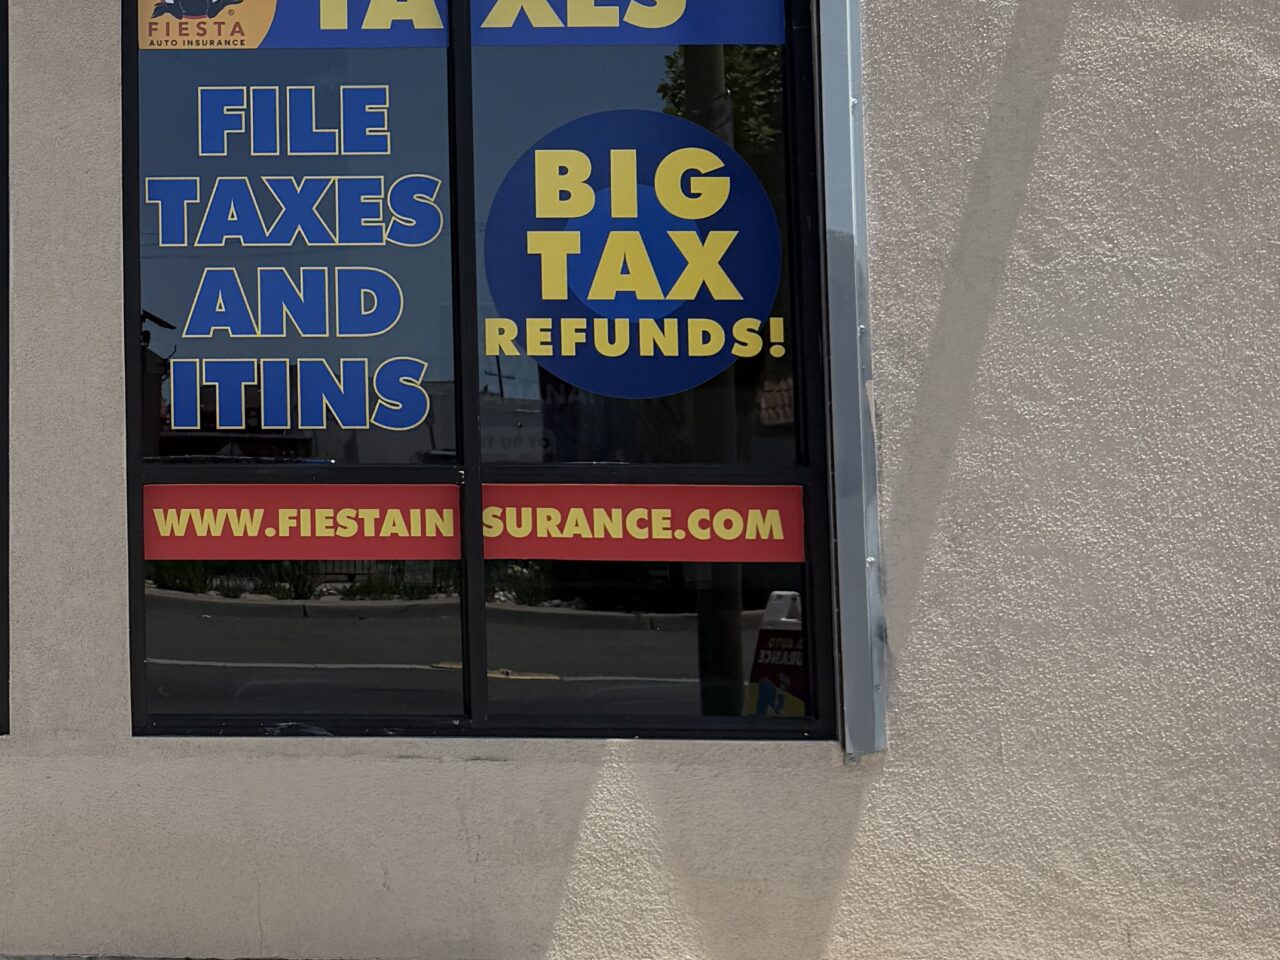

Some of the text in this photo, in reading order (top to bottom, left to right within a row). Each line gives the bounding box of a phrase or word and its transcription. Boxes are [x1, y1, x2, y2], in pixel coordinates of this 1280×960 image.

[147, 21, 245, 37] FIESTA
[149, 39, 246, 47] AUTO INSURANCE
[197, 84, 391, 156] FILE
[146, 173, 444, 248] TAXES
[534, 147, 731, 220] BIG
[527, 230, 743, 301] TAX
[181, 266, 405, 338] AND
[484, 317, 786, 358] REFUNDS!
[170, 357, 430, 430] ITINS
